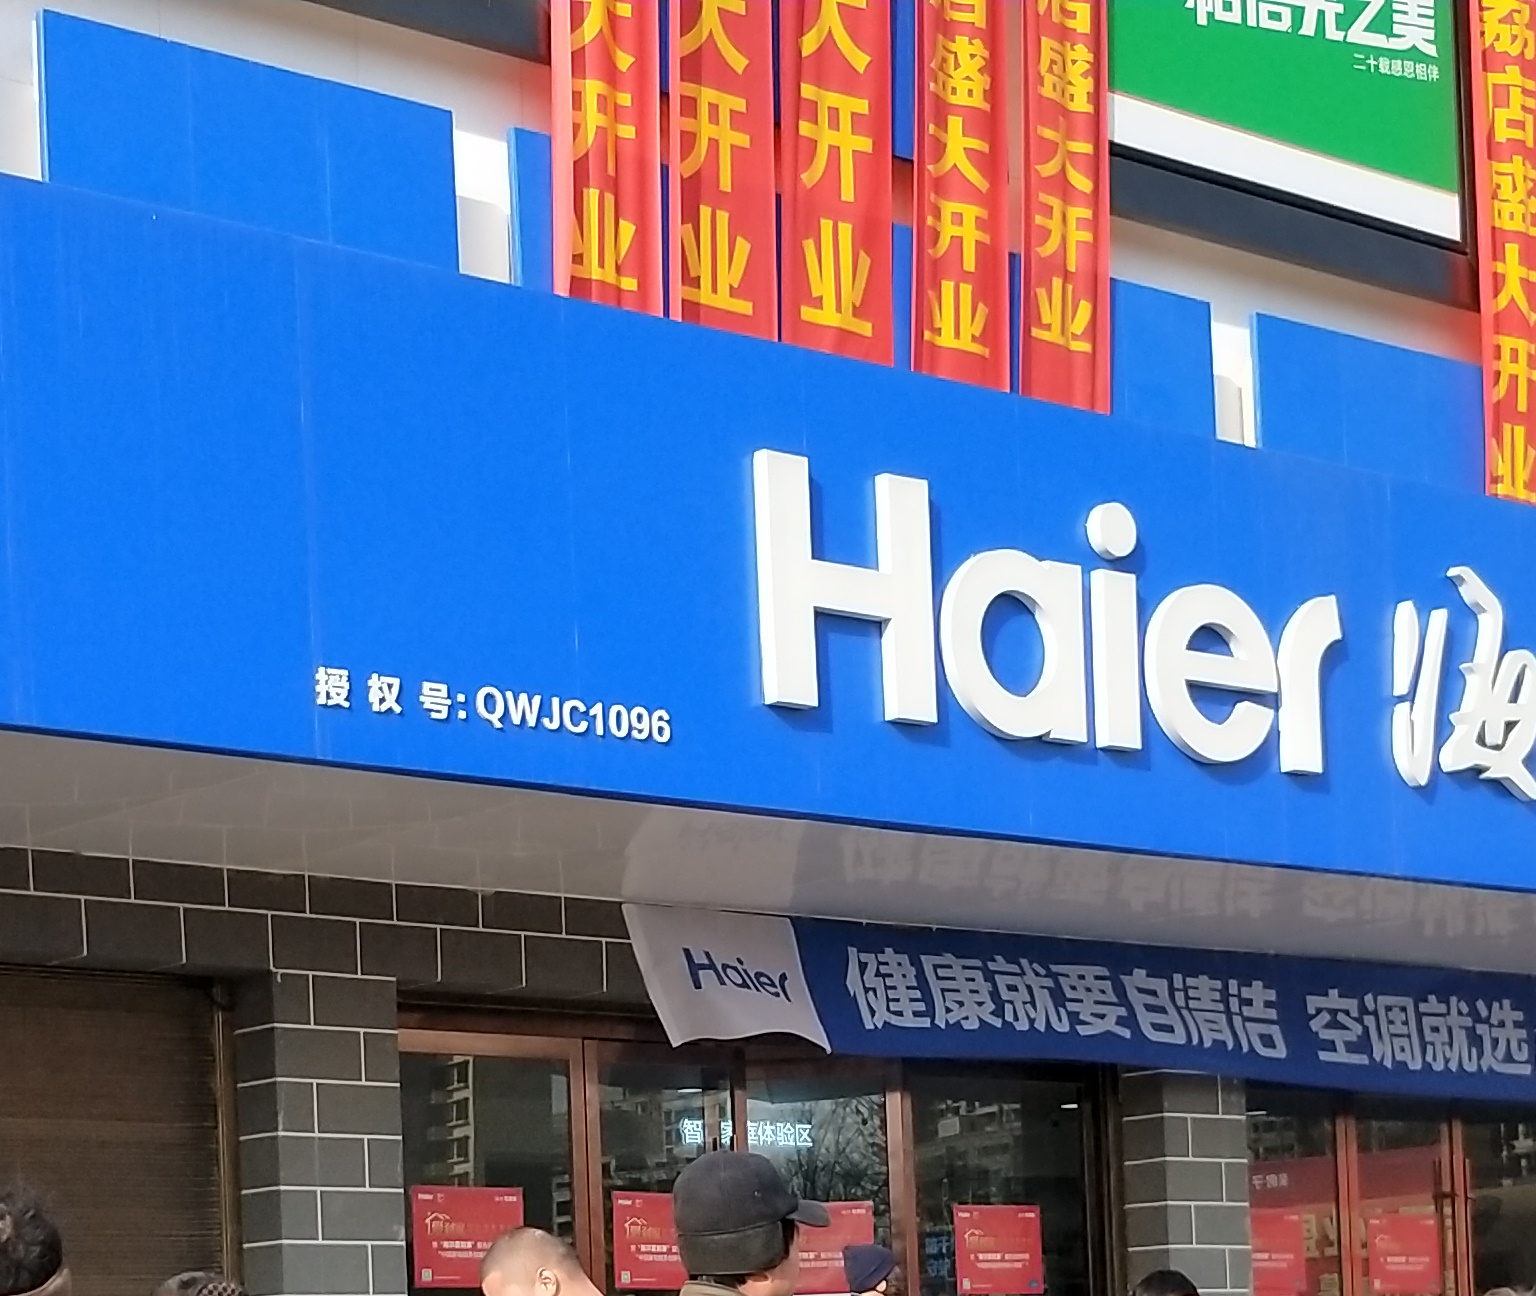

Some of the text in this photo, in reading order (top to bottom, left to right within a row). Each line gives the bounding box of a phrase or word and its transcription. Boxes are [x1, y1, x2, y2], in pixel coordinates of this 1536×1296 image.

[753, 448, 1342, 776] Haier
[681, 946, 790, 1004] Haier
[845, 945, 1288, 1061] 健康就要自清洁
[680, 1117, 813, 1147] 智家庭体验区
